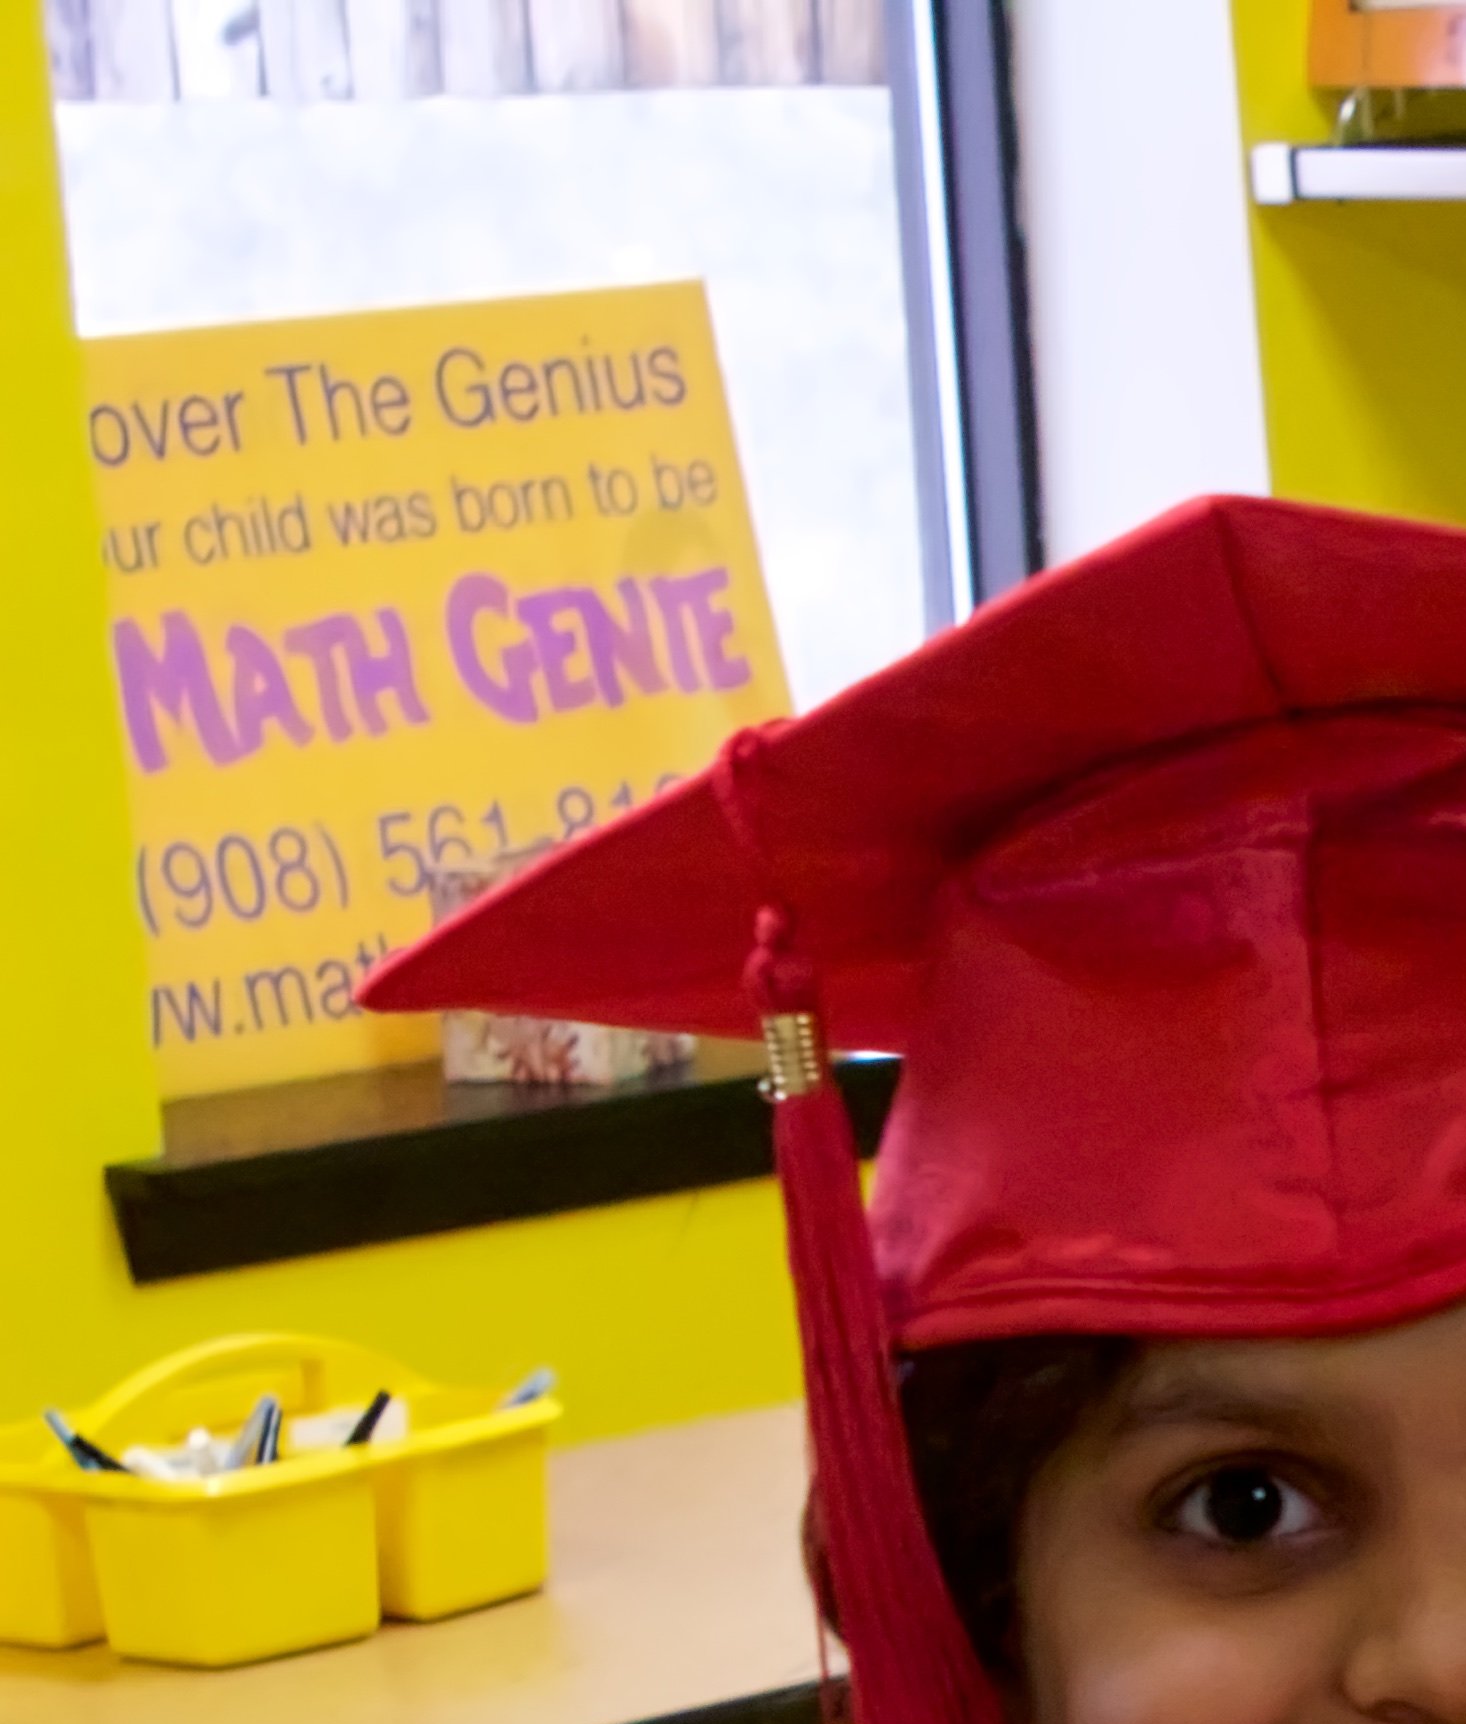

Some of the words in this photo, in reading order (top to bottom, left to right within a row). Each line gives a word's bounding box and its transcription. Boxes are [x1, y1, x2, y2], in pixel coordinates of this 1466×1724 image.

[88, 389, 245, 468] over
[263, 362, 412, 446] The
[433, 333, 688, 428] Genius
[101, 519, 162, 575] ur
[183, 492, 312, 567] child
[327, 491, 438, 547] was
[448, 473, 575, 533] born
[587, 461, 639, 517] to
[648, 451, 718, 512] be
[111, 609, 431, 775] MATH
[445, 567, 753, 724] GENIE
[135, 820, 350, 938] (908)
[377, 772, 690, 897] 561-8
[151, 931, 390, 1050] w.ma
